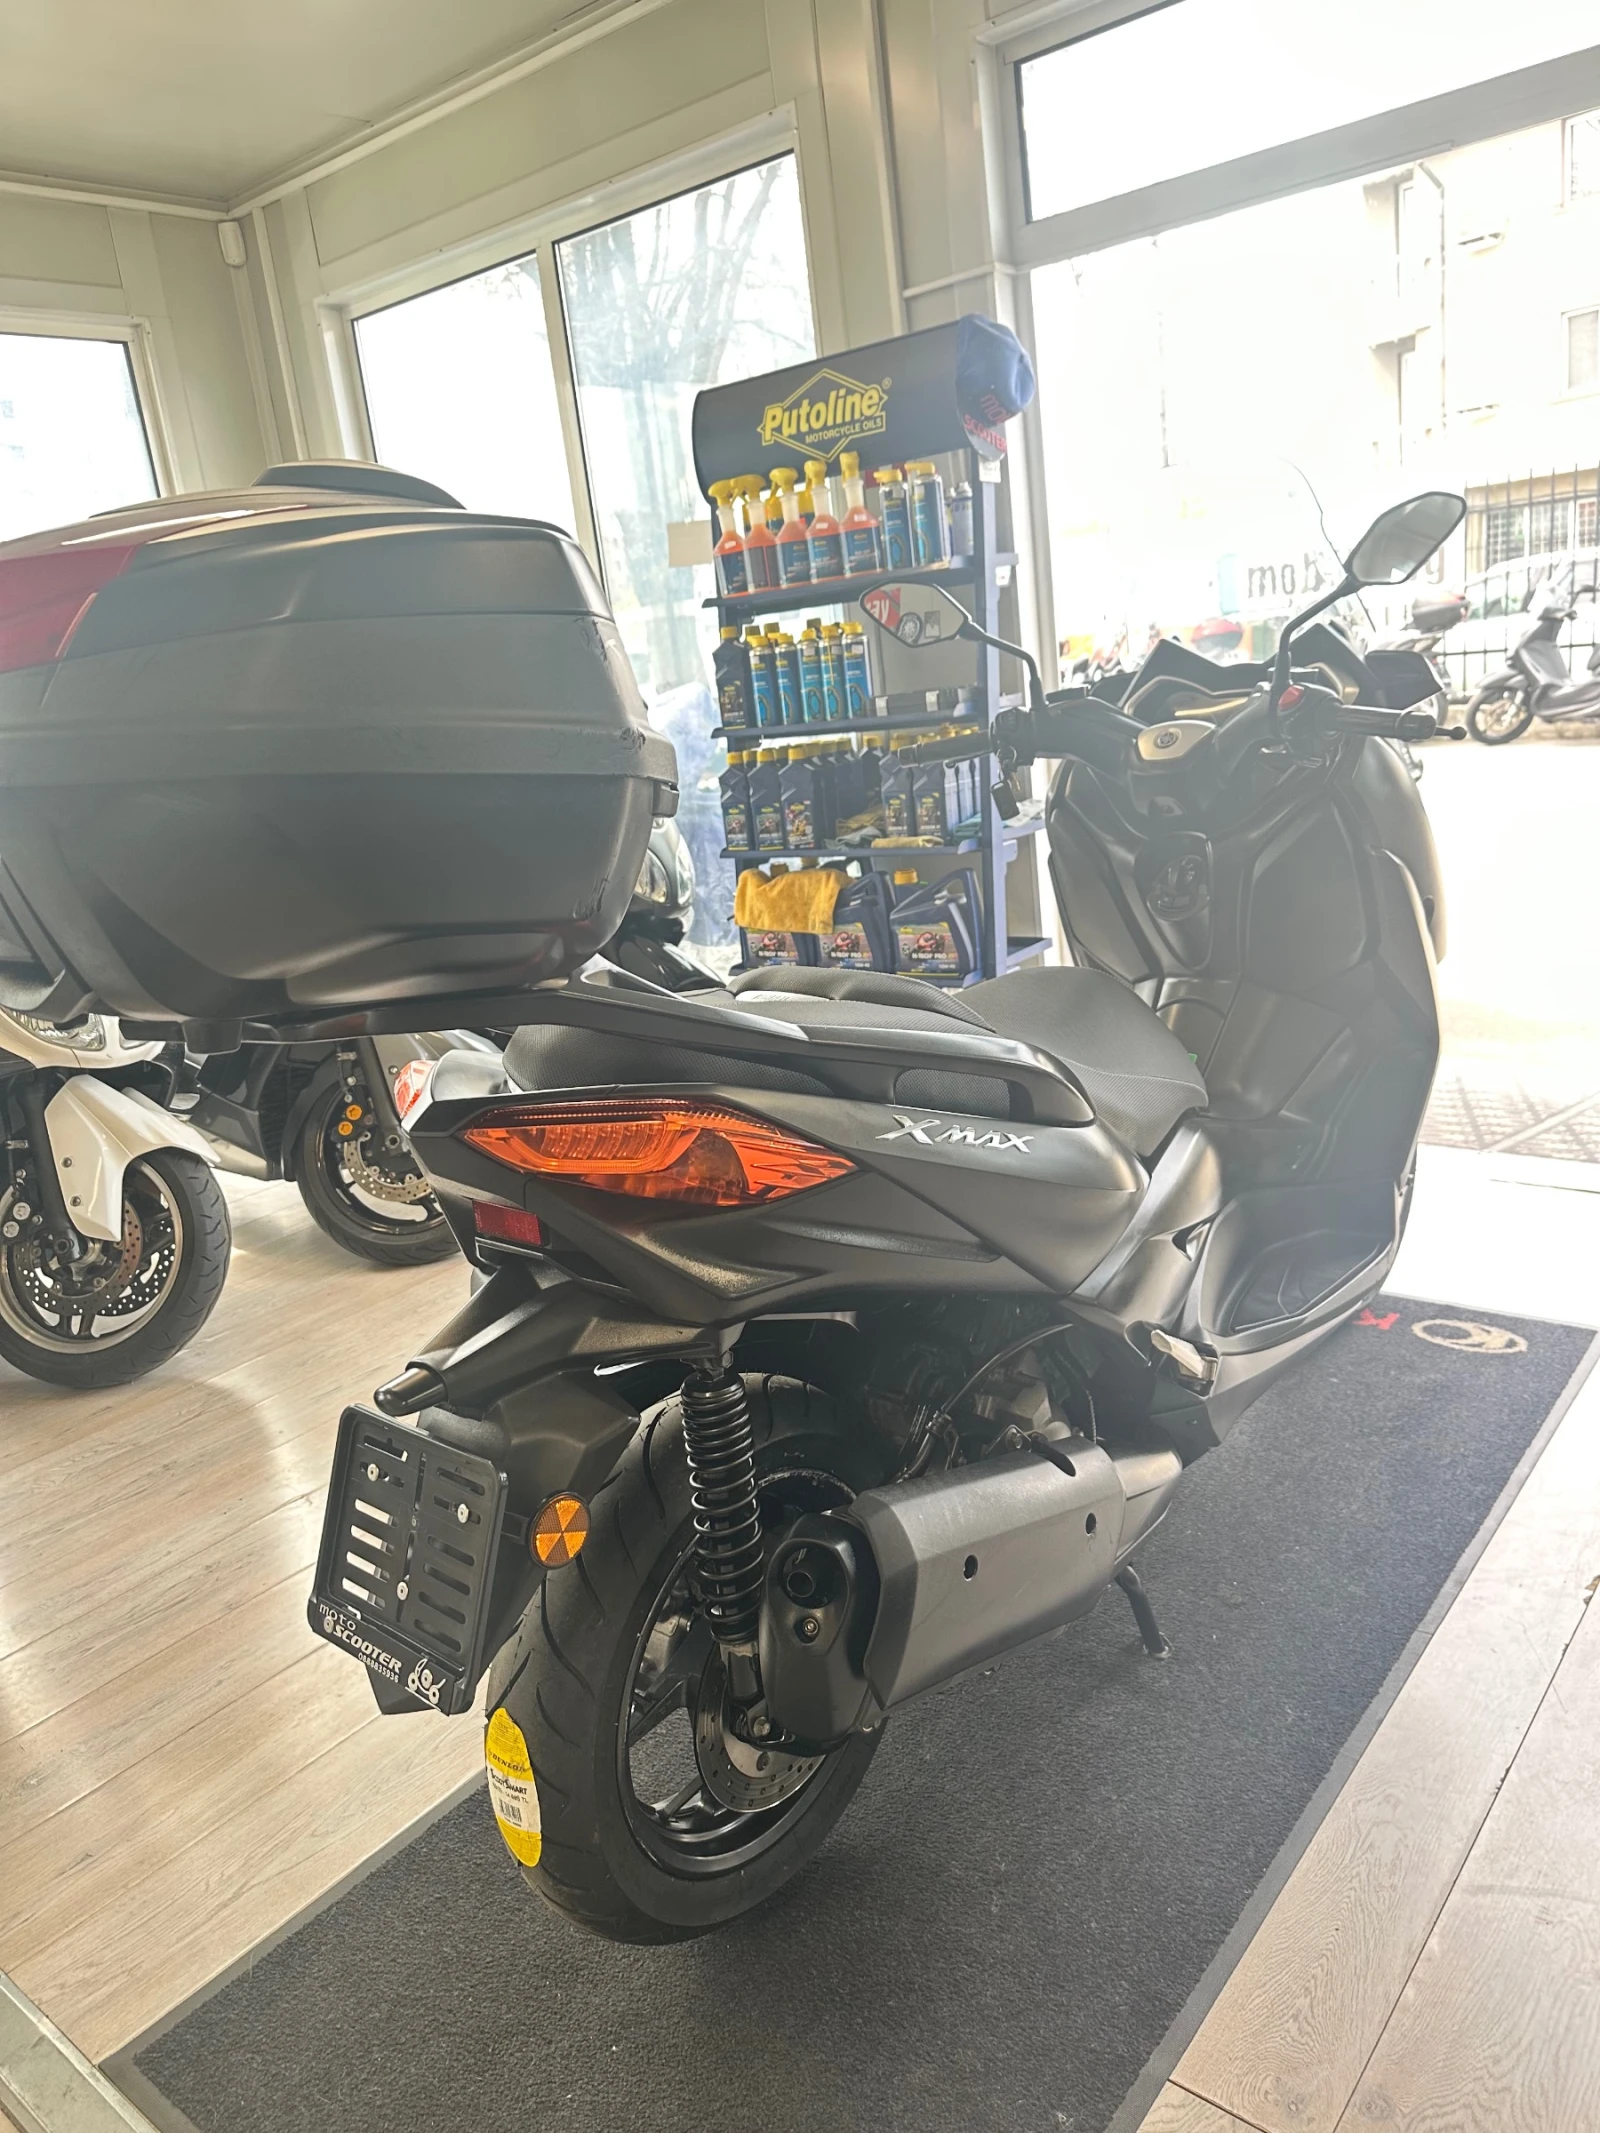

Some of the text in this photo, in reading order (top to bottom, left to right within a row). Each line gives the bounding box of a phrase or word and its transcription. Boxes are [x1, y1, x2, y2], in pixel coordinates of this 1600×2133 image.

[763, 387, 880, 442] Putoline
[805, 417, 882, 444] MOTORCYCLE OILS
[319, 1603, 356, 1631] moto
[333, 1624, 402, 1674] SCOOTER
